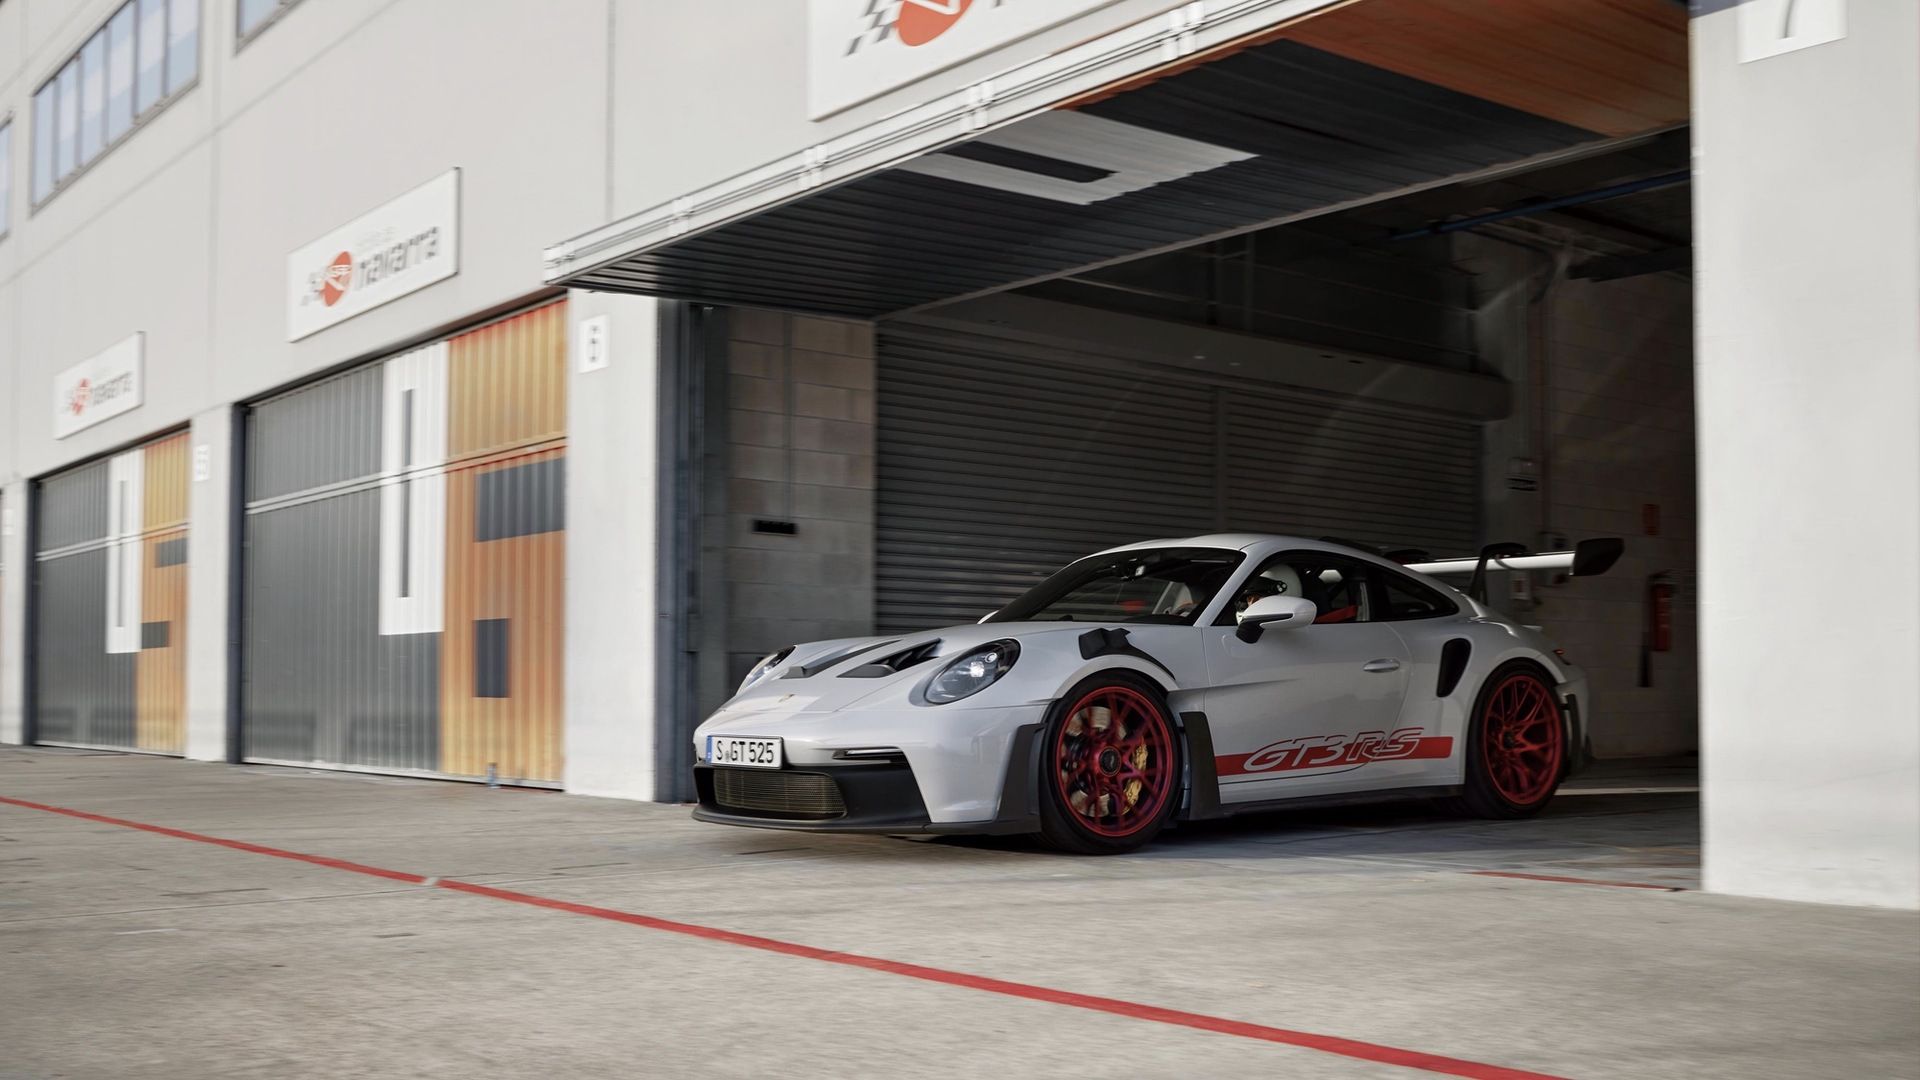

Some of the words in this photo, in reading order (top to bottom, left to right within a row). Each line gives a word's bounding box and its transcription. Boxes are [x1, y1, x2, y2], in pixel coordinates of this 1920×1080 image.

[716, 740, 724, 761] S
[730, 741, 746, 762] GT
[748, 741, 774, 764] 525
